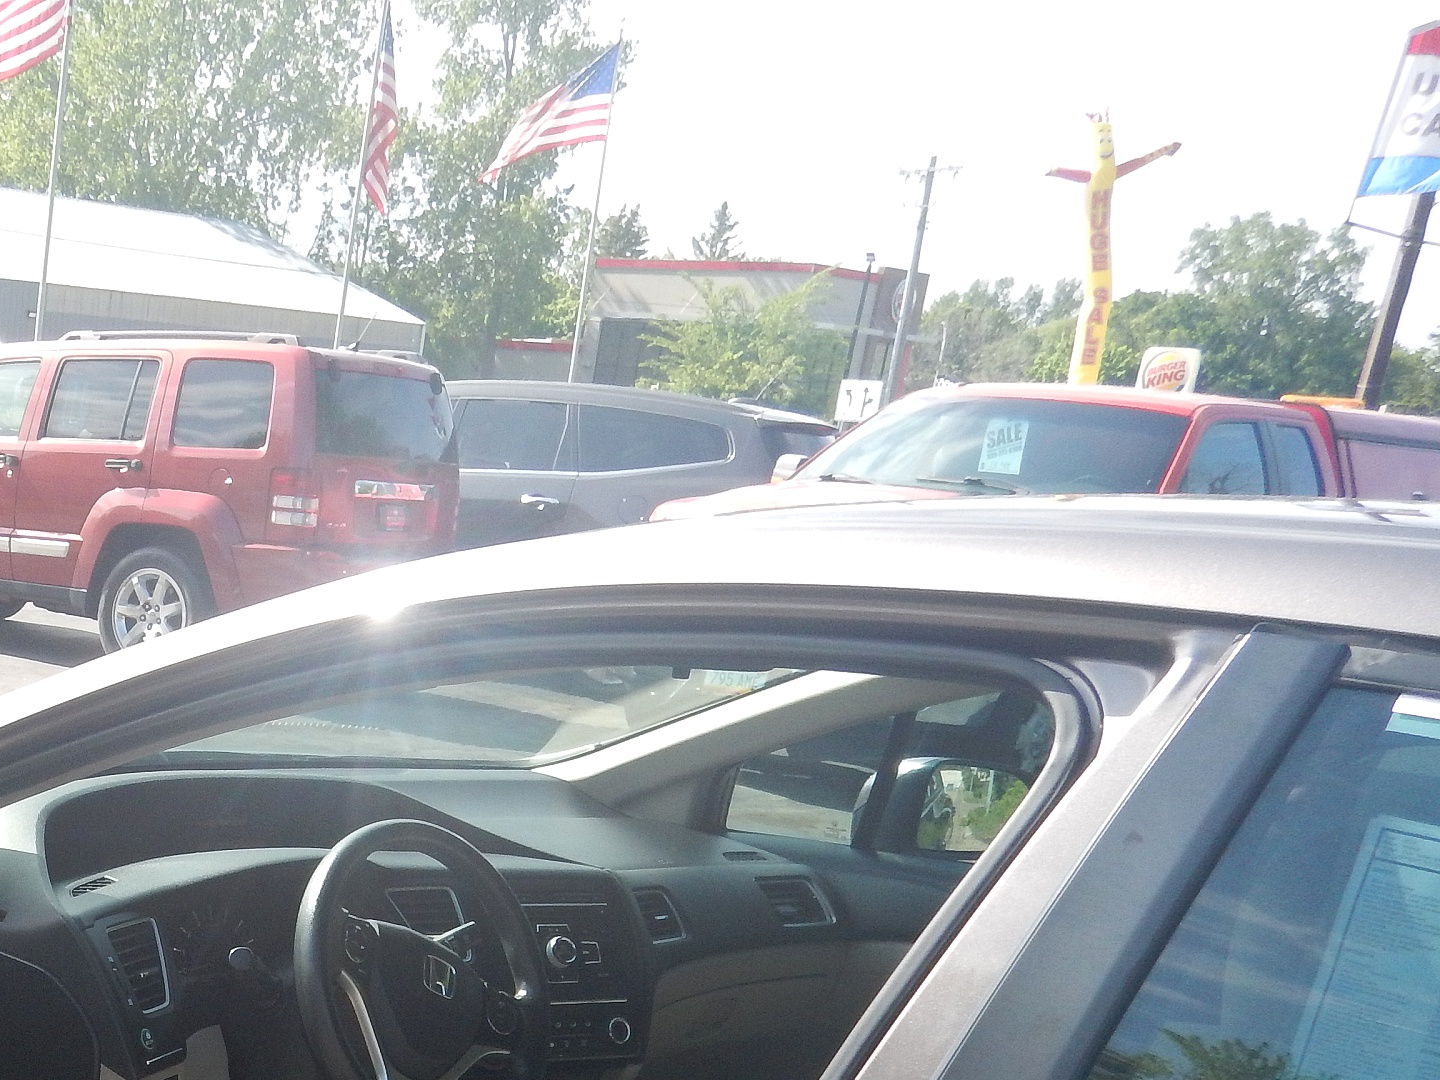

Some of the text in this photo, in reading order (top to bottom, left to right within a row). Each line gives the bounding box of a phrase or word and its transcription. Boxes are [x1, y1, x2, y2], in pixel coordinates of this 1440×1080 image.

[1412, 72, 1440, 95] U
[1401, 112, 1440, 137] CA
[1080, 190, 1109, 366] HUGE SALE
[1146, 370, 1186, 389] KING
[1147, 360, 1187, 378] BURGER
[986, 423, 1023, 449] SALE
